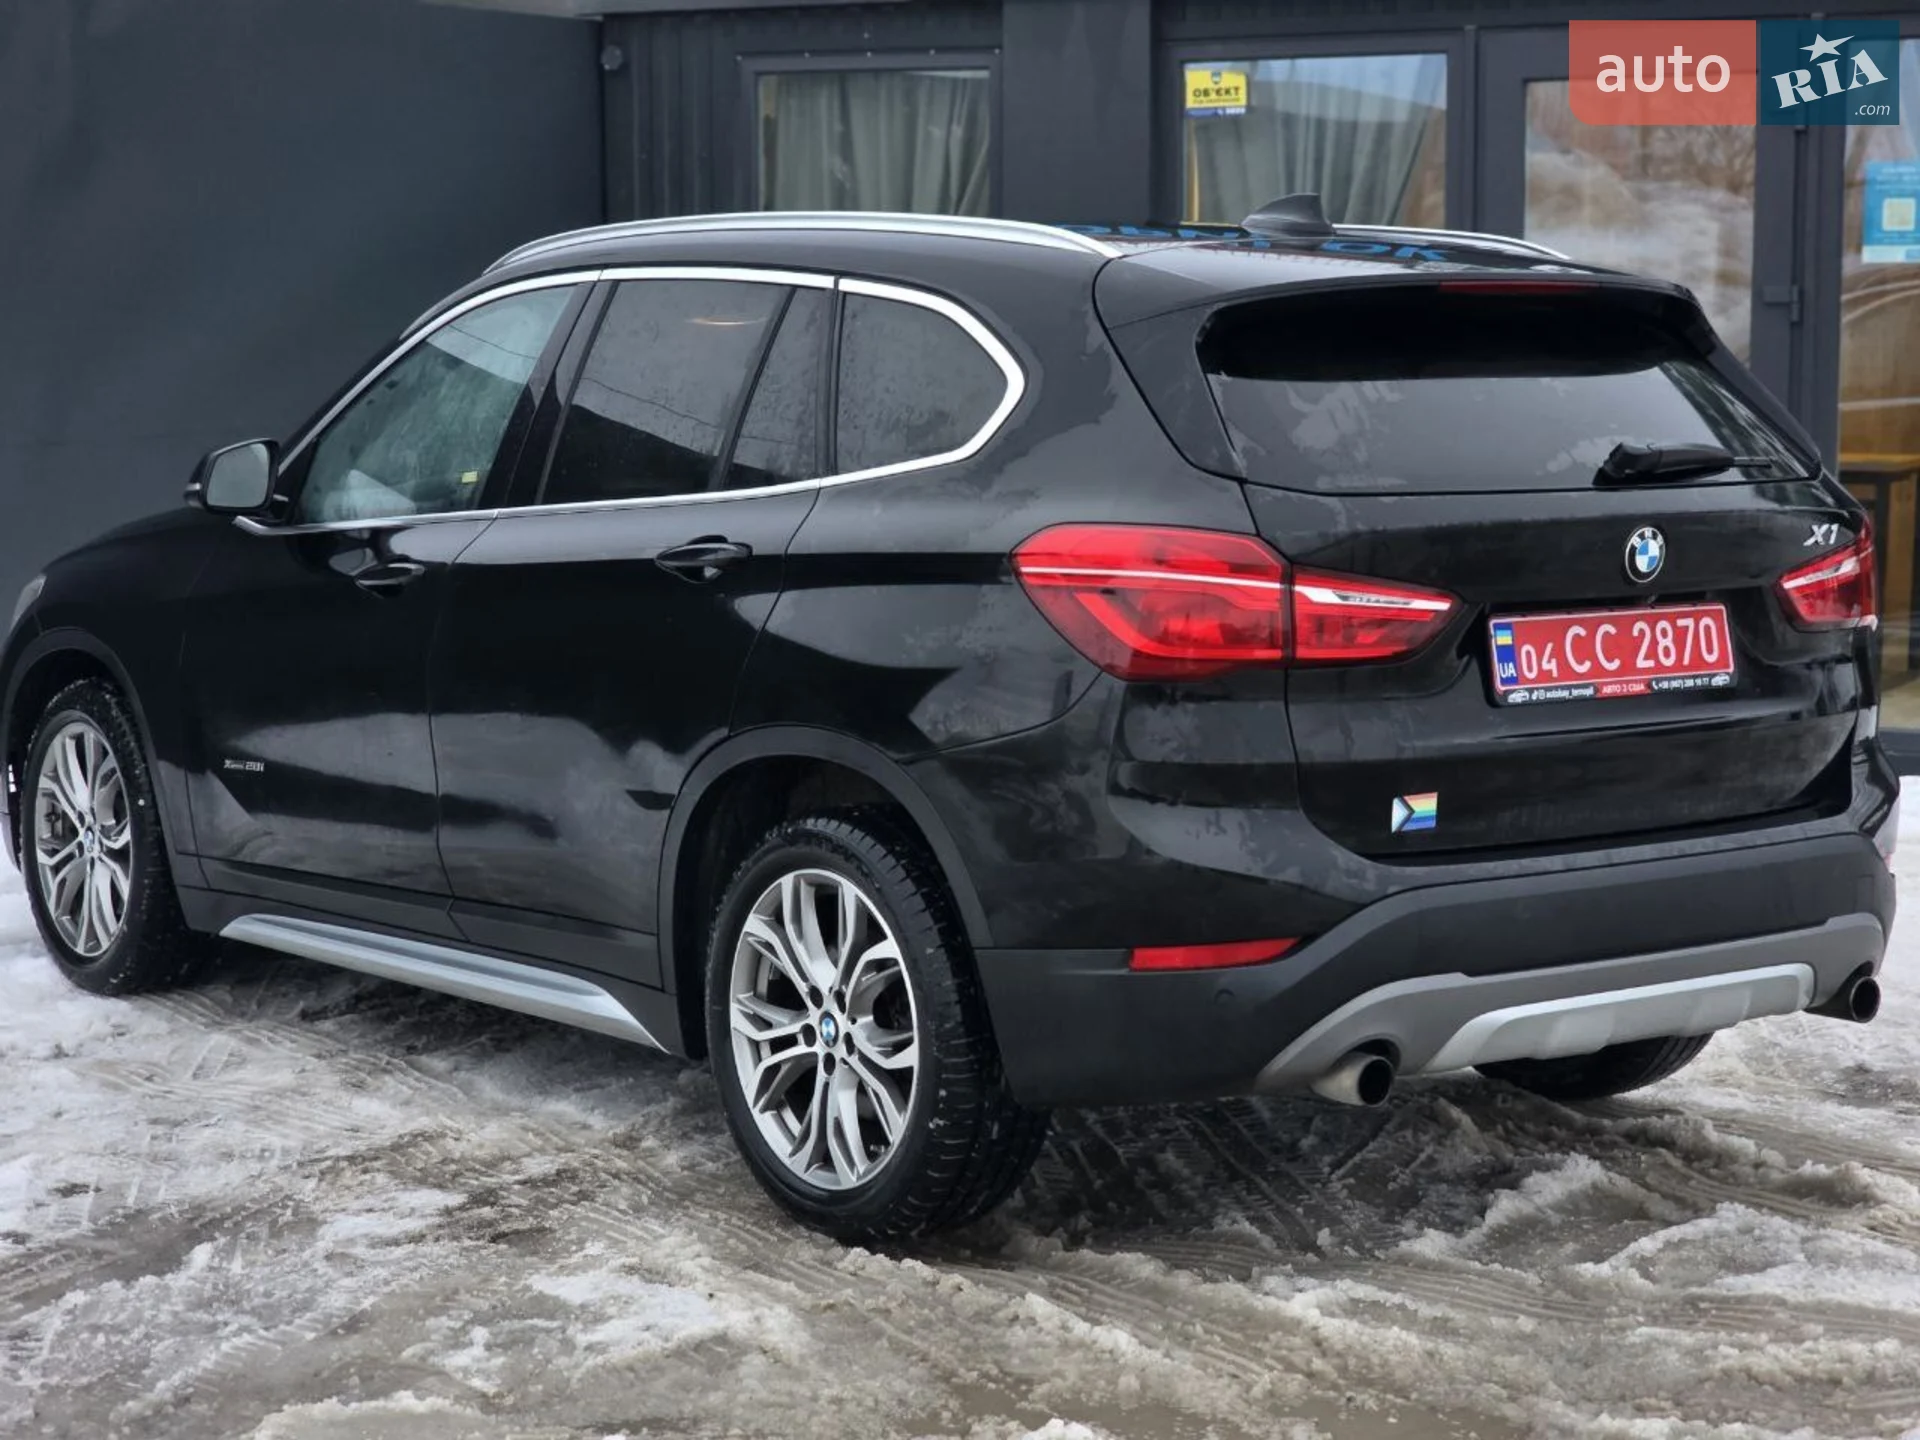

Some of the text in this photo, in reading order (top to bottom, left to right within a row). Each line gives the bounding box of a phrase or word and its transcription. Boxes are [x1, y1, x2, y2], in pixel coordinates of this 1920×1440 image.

[1803, 523, 1839, 546] X1
[1520, 616, 1719, 680] 04 CC 2870
[1500, 662, 1517, 679] UA
